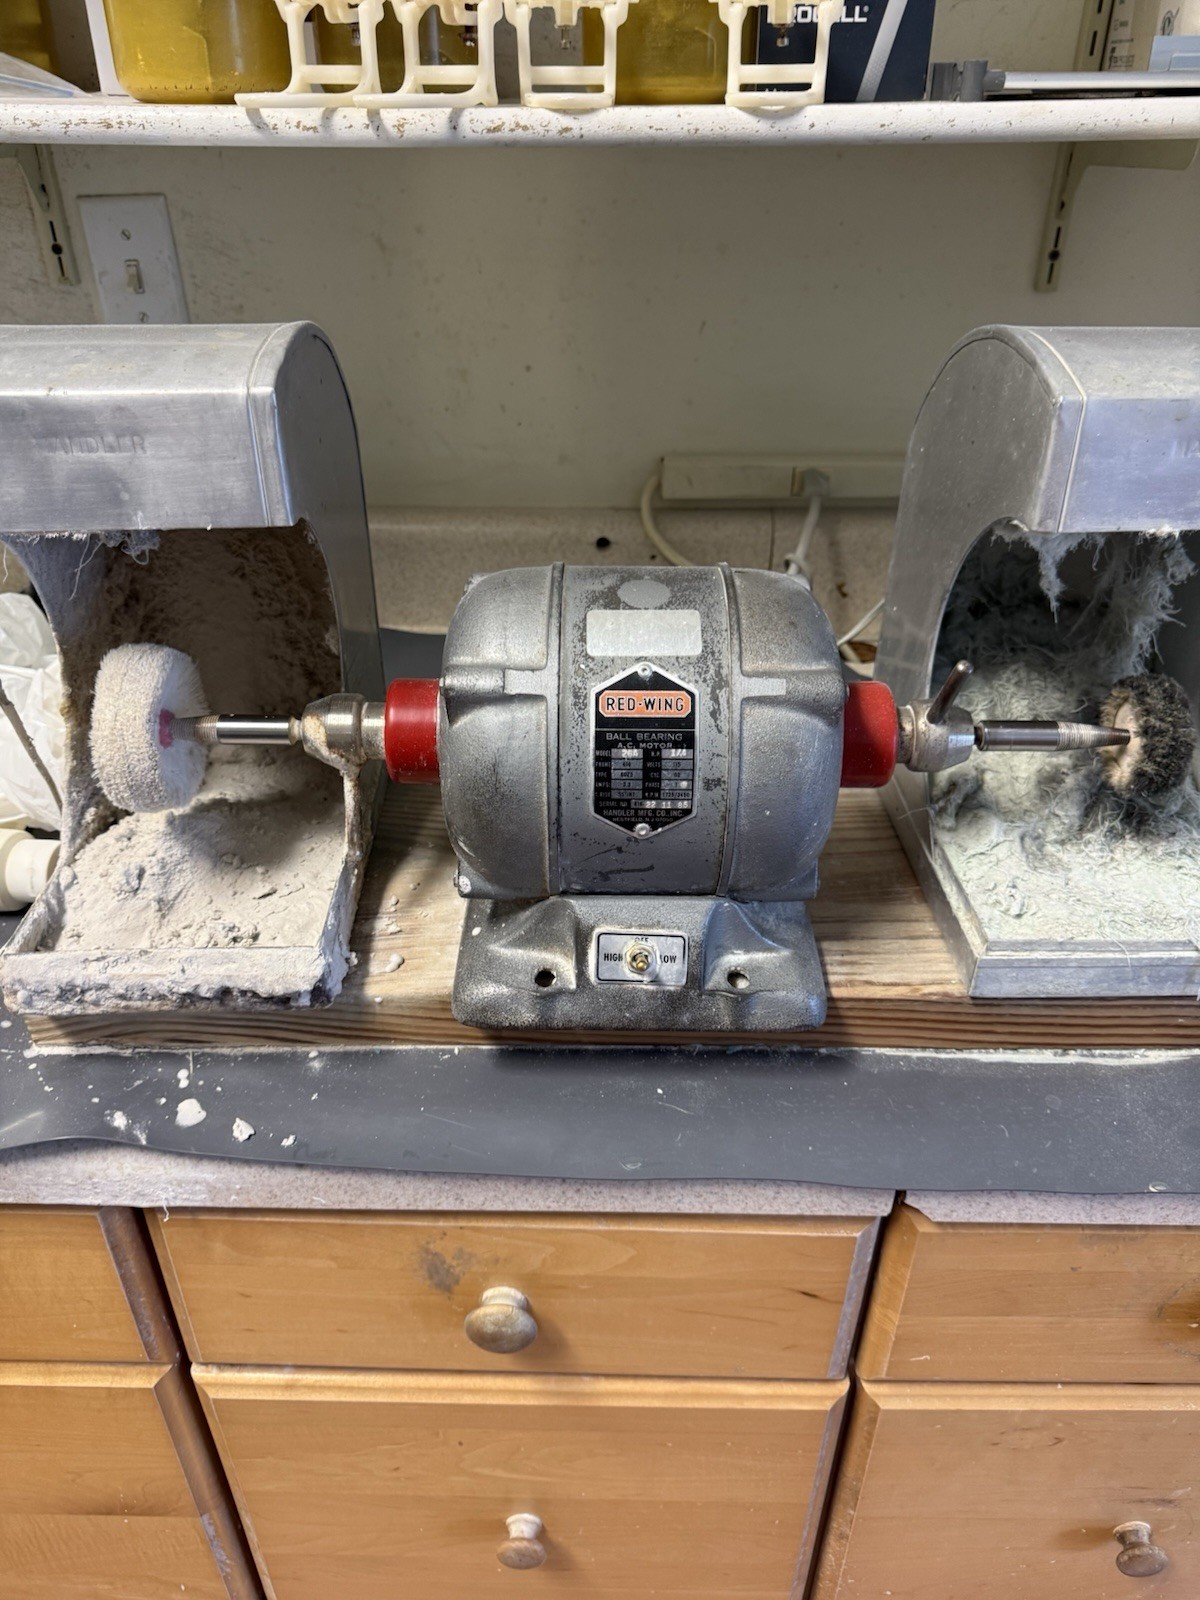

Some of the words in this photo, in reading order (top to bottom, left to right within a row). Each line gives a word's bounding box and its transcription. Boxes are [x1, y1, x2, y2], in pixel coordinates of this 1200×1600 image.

[767, 6, 867, 23] OCLL
[606, 697, 684, 711] RED-WING
[606, 732, 632, 741] BALL
[636, 732, 683, 741] BEARING
[661, 801, 672, 809] 11
[603, 809, 635, 817] HANDLER
[603, 953, 624, 962] HIGH
